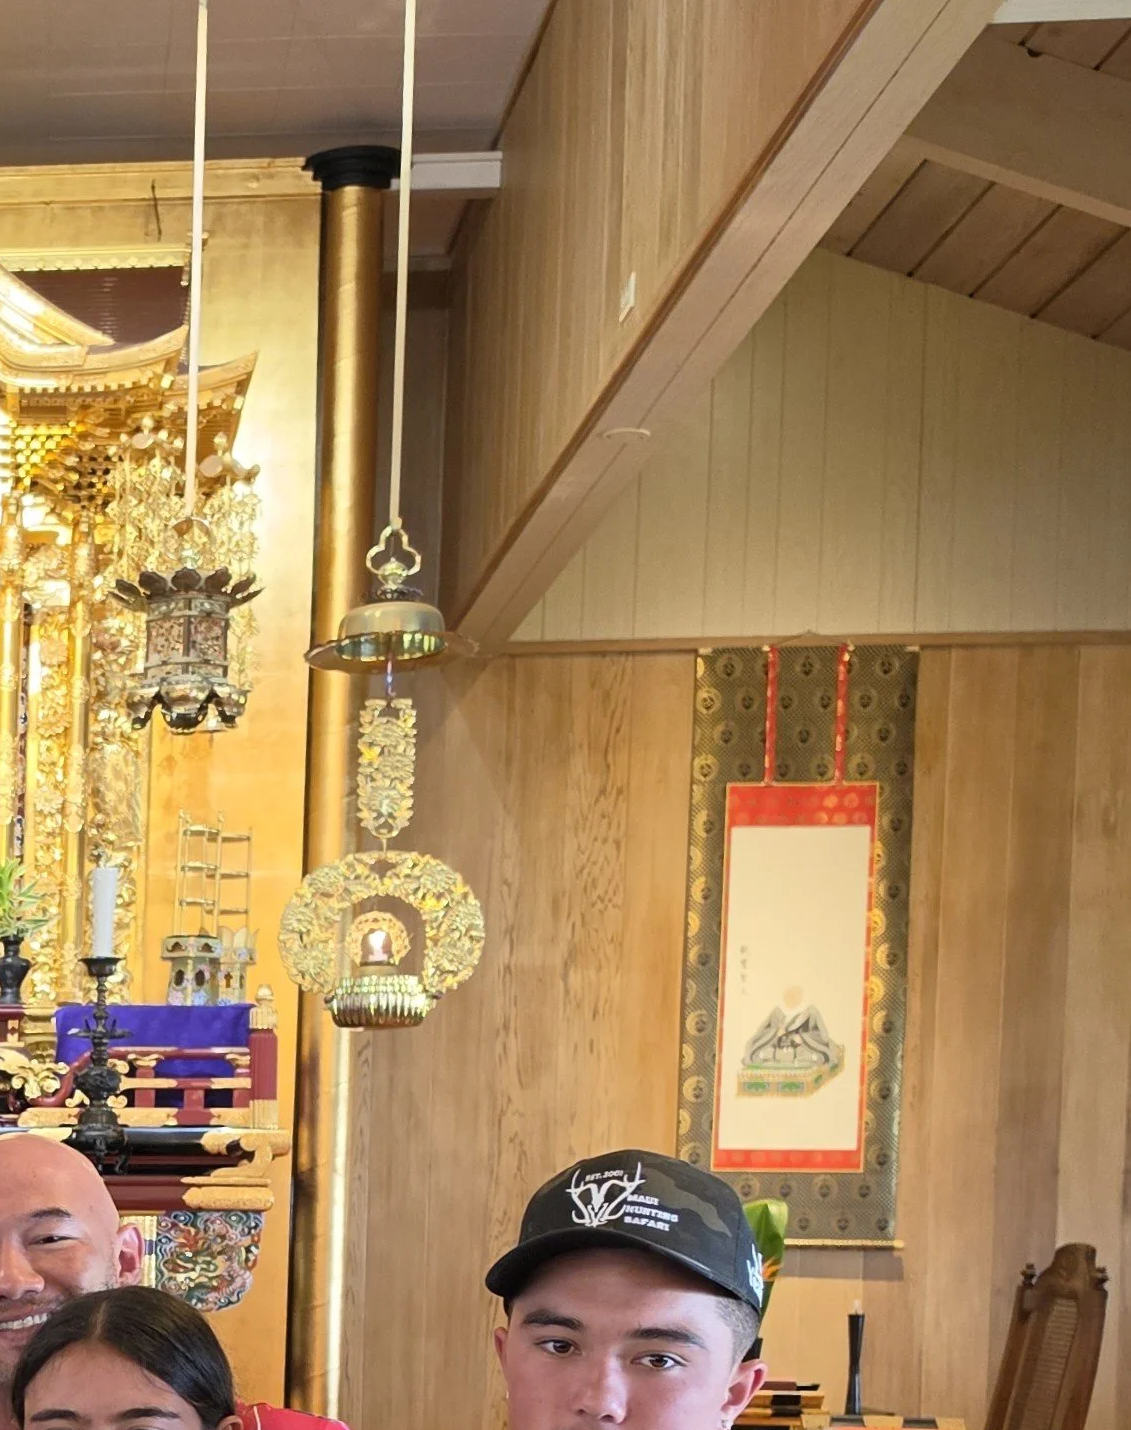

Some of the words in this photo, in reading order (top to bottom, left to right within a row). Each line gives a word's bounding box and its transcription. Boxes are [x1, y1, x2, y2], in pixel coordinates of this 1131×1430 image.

[627, 1194, 659, 1206] MAUI
[625, 1205, 678, 1222] HUNTING
[624, 1216, 670, 1231] SAFARI
